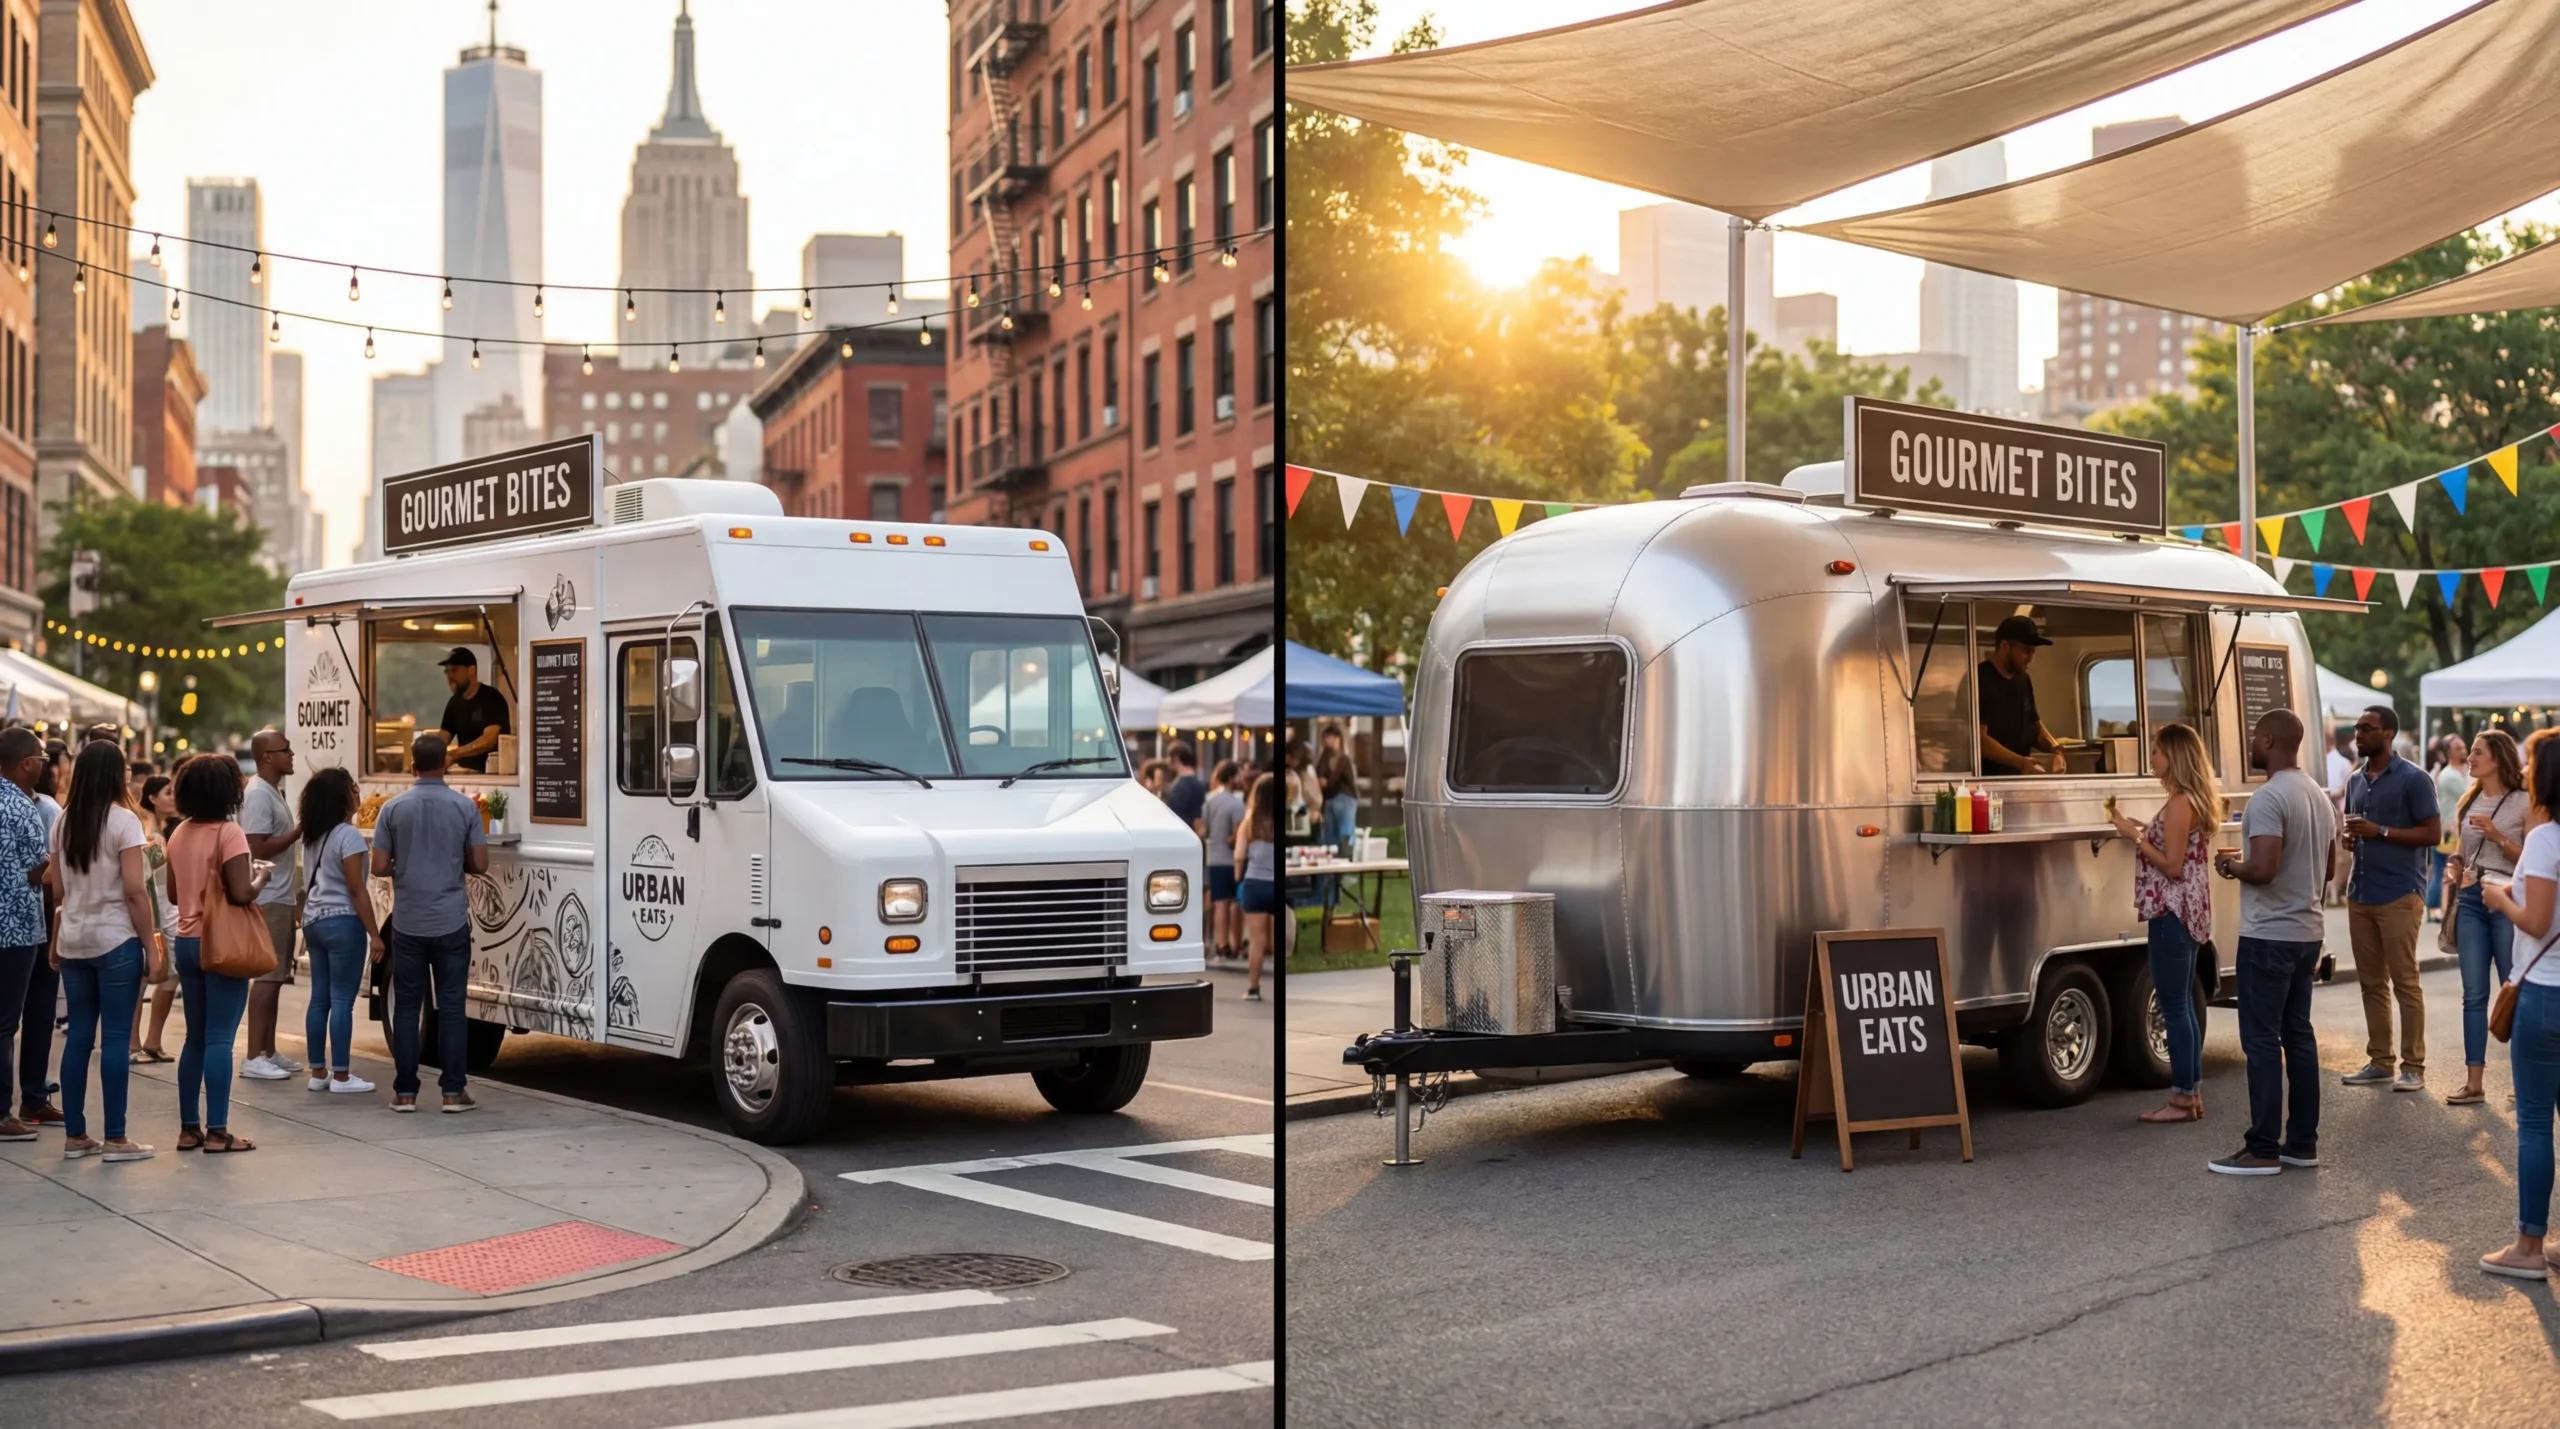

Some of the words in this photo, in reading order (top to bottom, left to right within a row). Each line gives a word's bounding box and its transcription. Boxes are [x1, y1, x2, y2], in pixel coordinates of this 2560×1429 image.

[1890, 429, 2044, 498] GOURMET
[2056, 452, 2138, 510] BITES
[401, 475, 499, 535] GOURMET
[506, 461, 572, 517] BITES
[297, 699, 350, 728] GOURMET
[311, 731, 337, 750] EATS
[622, 872, 685, 906] URBAN
[640, 907, 667, 925] EATS
[1840, 969, 1935, 1011] URBAN
[1859, 1015, 1928, 1055] EATS
